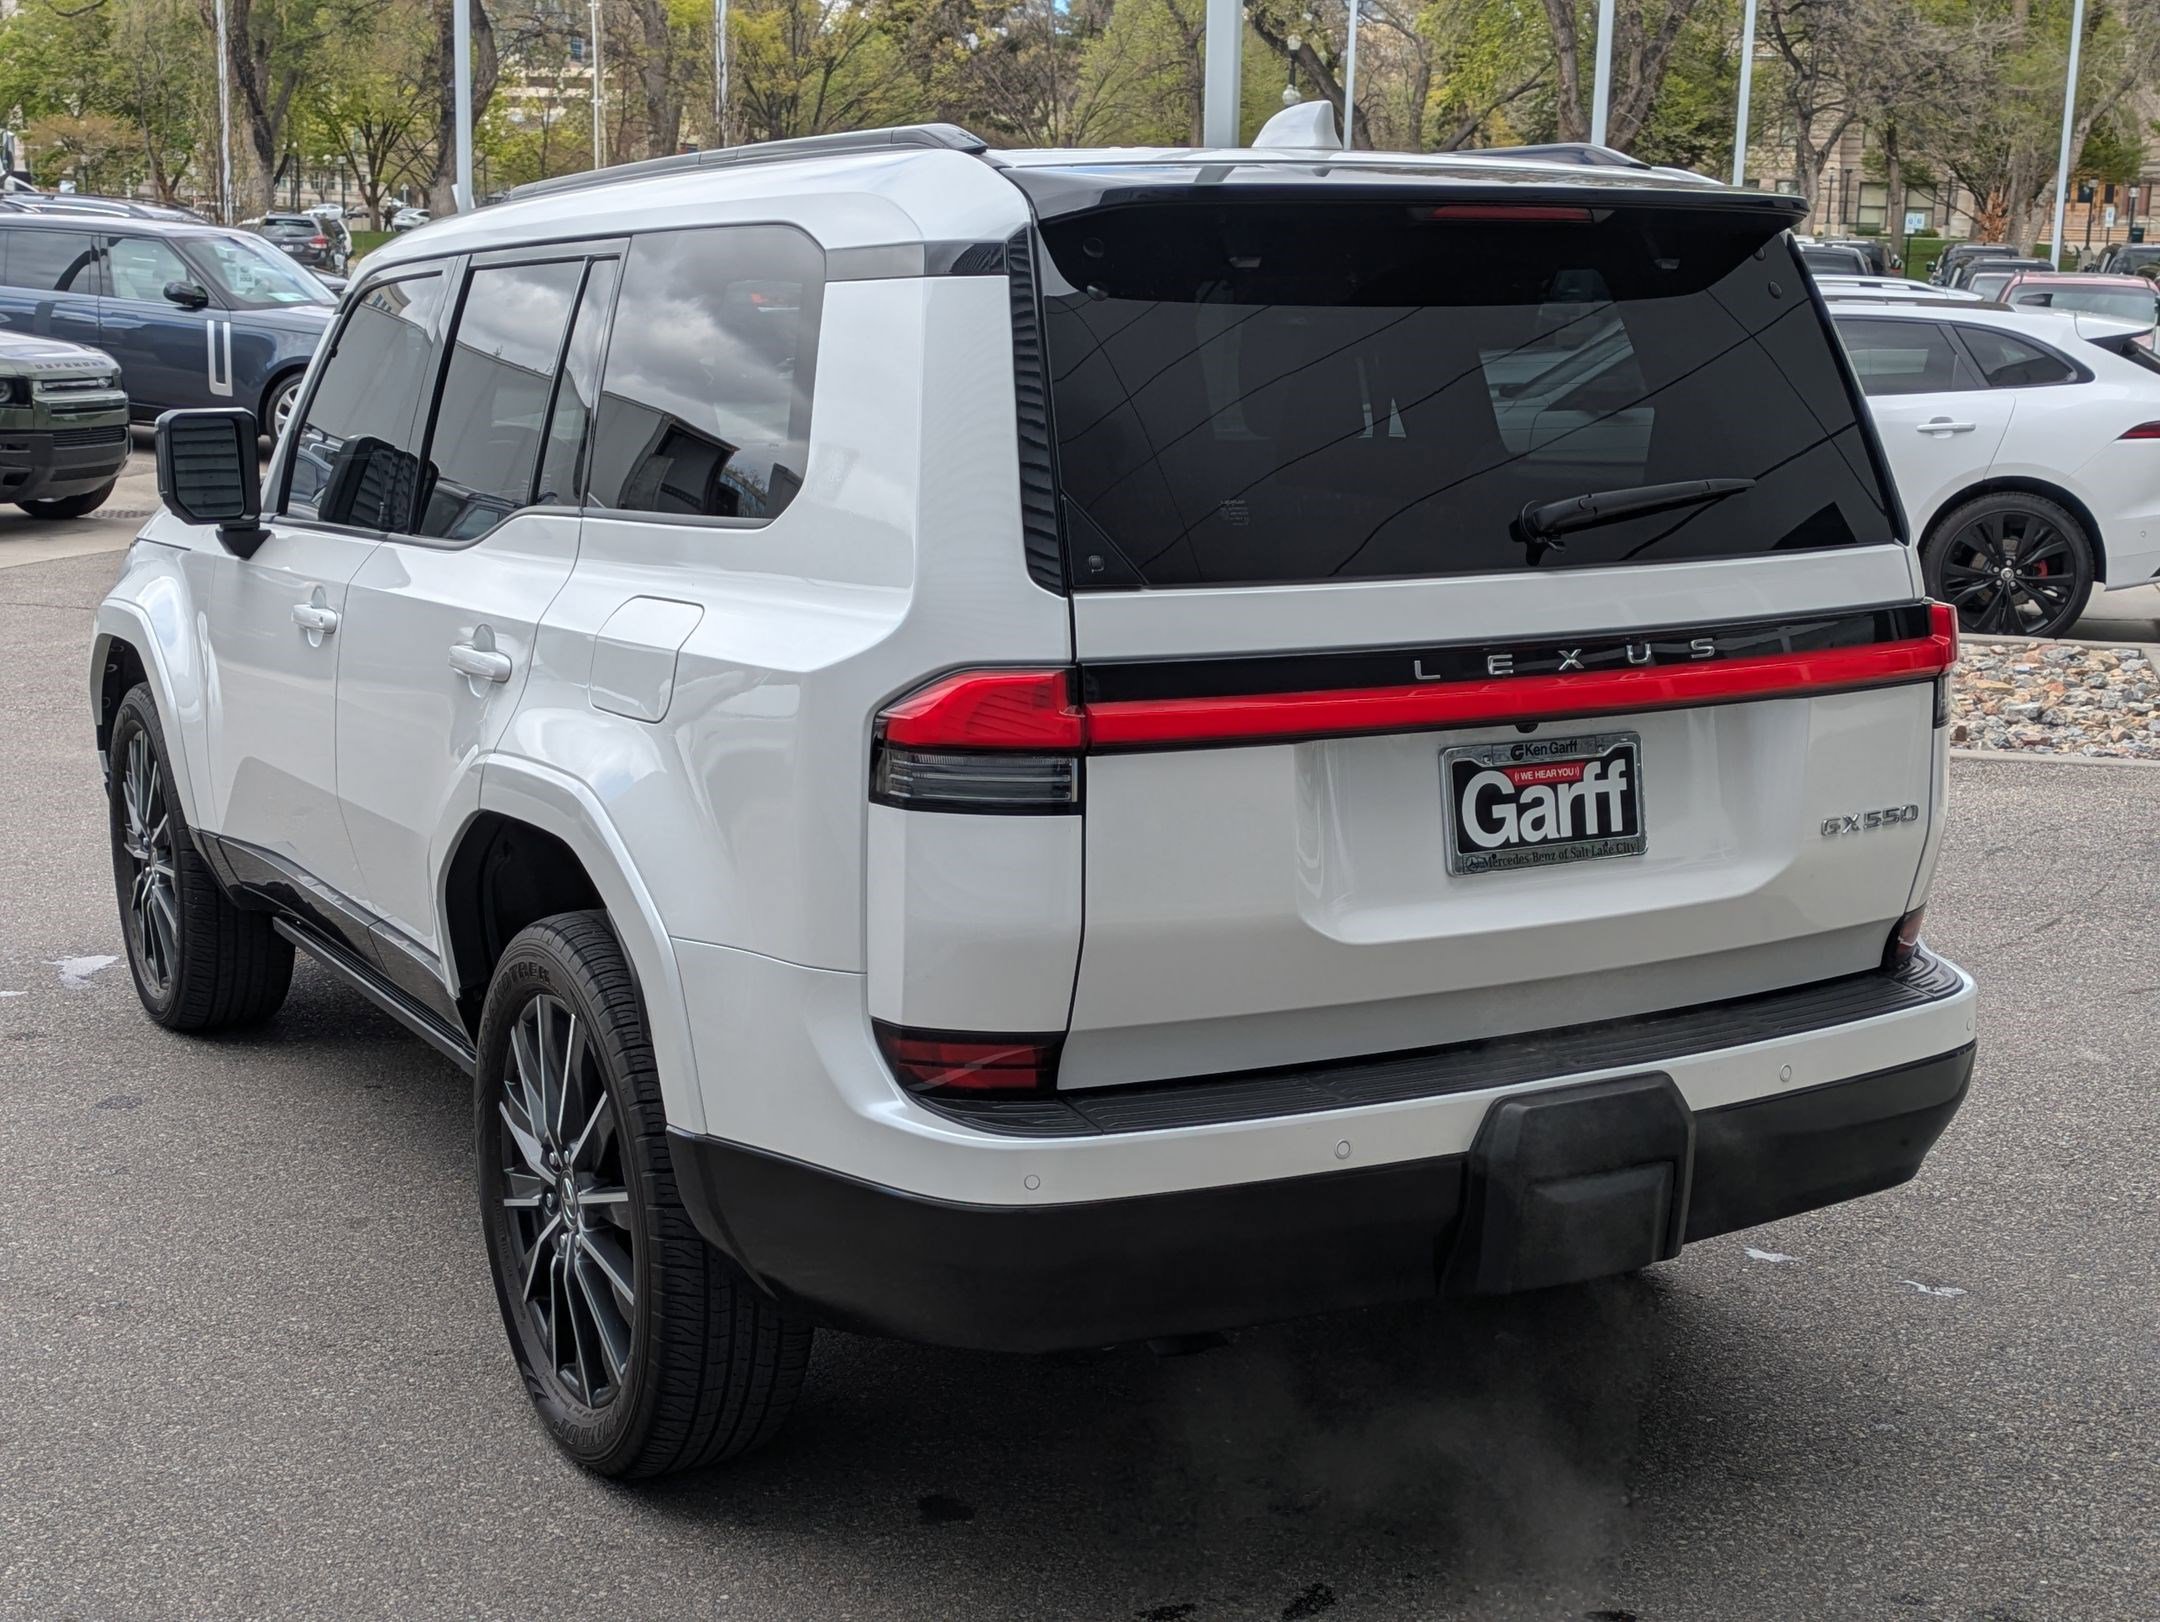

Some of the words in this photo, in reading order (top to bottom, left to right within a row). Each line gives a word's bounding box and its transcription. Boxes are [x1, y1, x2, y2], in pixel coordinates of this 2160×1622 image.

[1414, 637, 1716, 680] LEXUS
[1524, 743, 1548, 757] Ken
[1549, 740, 1578, 754] Garff
[1520, 771, 1534, 780] WE
[1535, 769, 1557, 779] HEAR
[1557, 767, 1574, 777] YOU
[1462, 759, 1628, 848] Garff
[1558, 848, 1569, 860] of
[1570, 845, 1590, 858] Salt
[1592, 842, 1614, 856] Lake
[1616, 840, 1637, 854] City
